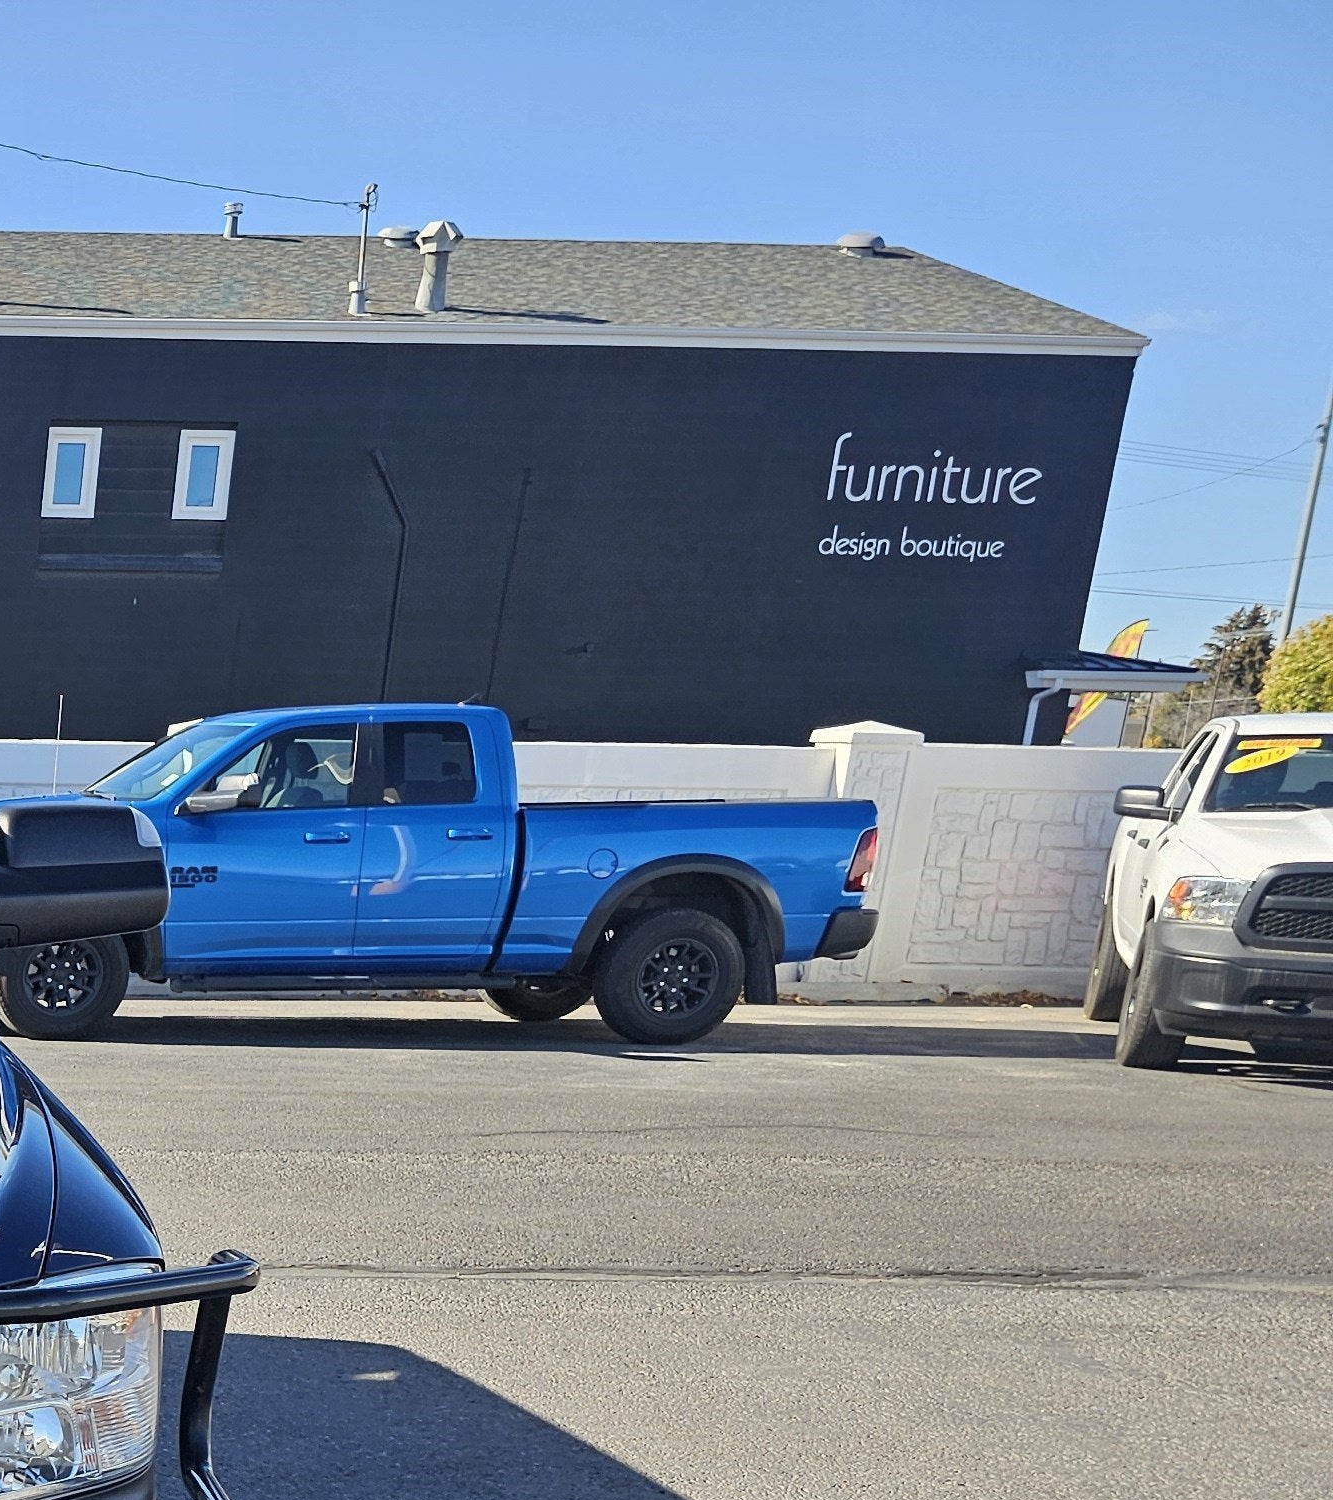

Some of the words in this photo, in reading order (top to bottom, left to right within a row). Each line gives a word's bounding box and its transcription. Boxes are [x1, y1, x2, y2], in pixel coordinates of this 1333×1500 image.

[826, 431, 1043, 505] furniture
[818, 524, 890, 561] design
[900, 526, 1005, 563] boutique
[171, 875, 218, 883] 1500
